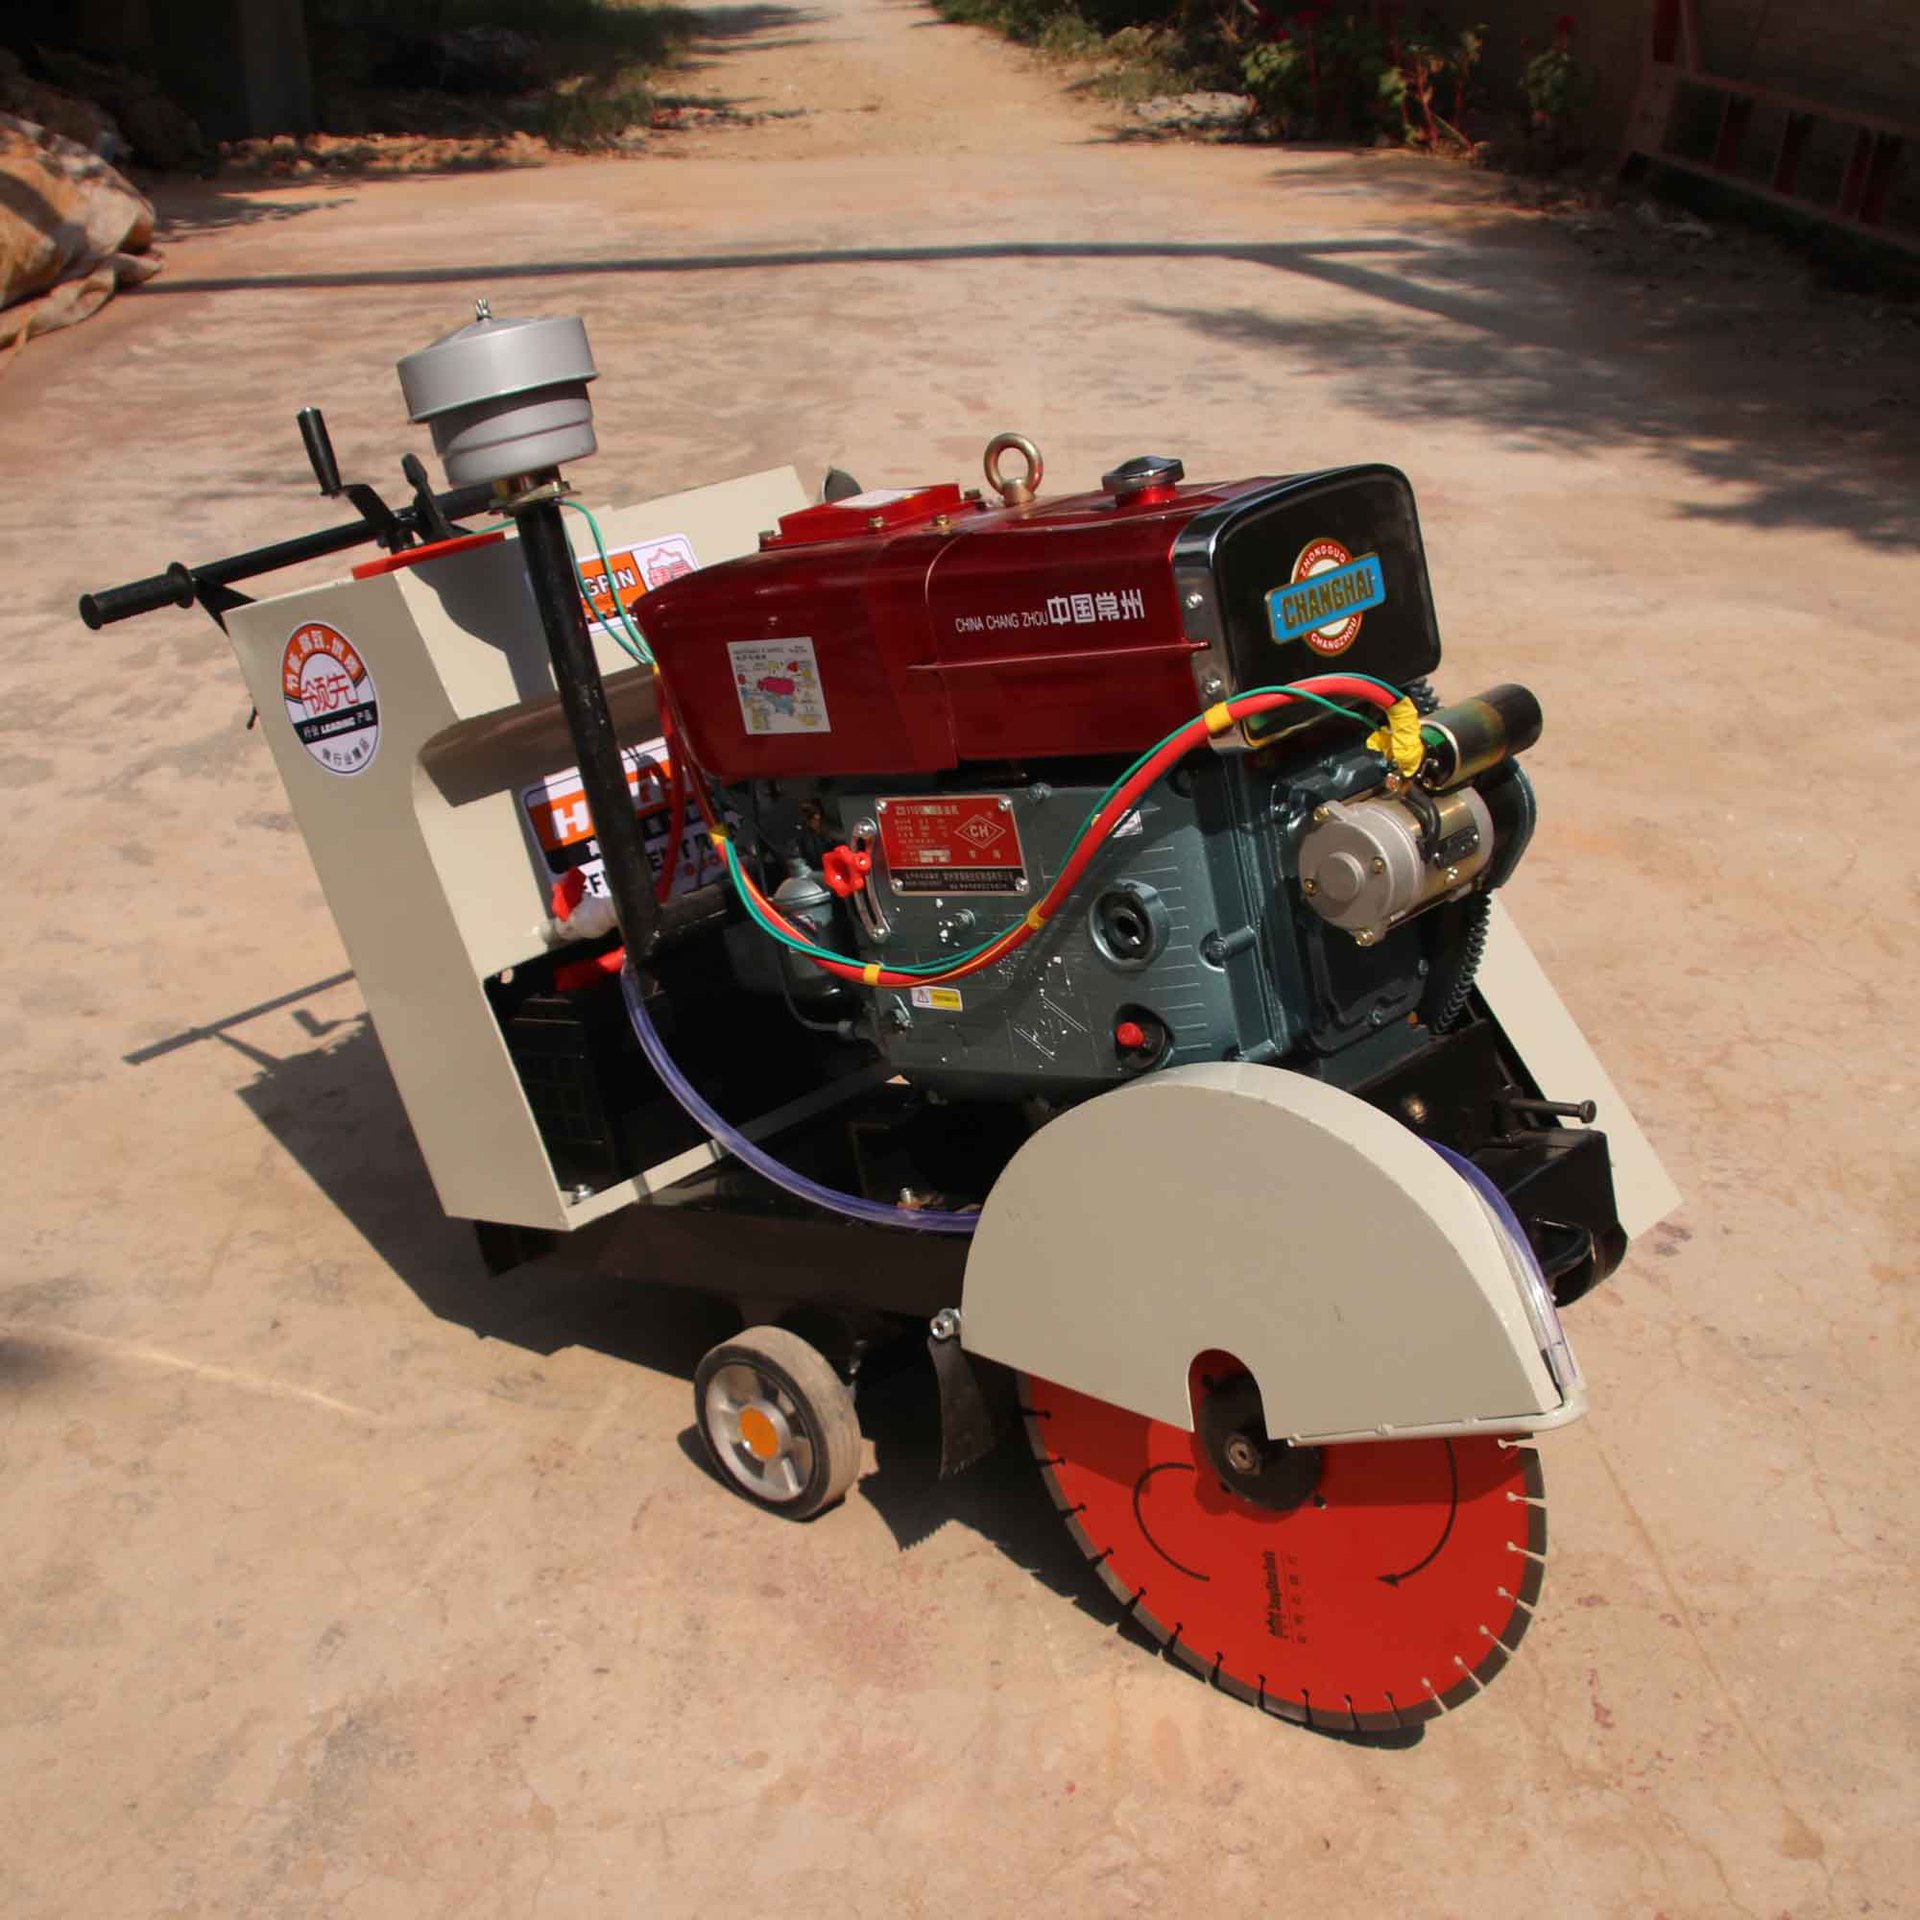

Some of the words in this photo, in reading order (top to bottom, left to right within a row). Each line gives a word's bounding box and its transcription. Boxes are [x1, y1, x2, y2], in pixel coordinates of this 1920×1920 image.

[1301, 545, 1346, 577] ZHONGGUO
[580, 567, 637, 598] GPIN
[1282, 567, 1375, 630] CHANGHAI
[955, 616, 985, 633] CHINA
[986, 612, 1020, 631] CHANG
[1022, 610, 1049, 628] ZHOU
[1047, 588, 1145, 626] 中国常州
[1311, 617, 1357, 650] CHANGZHOU
[301, 674, 359, 716] 领先
[968, 825, 990, 839] CH
